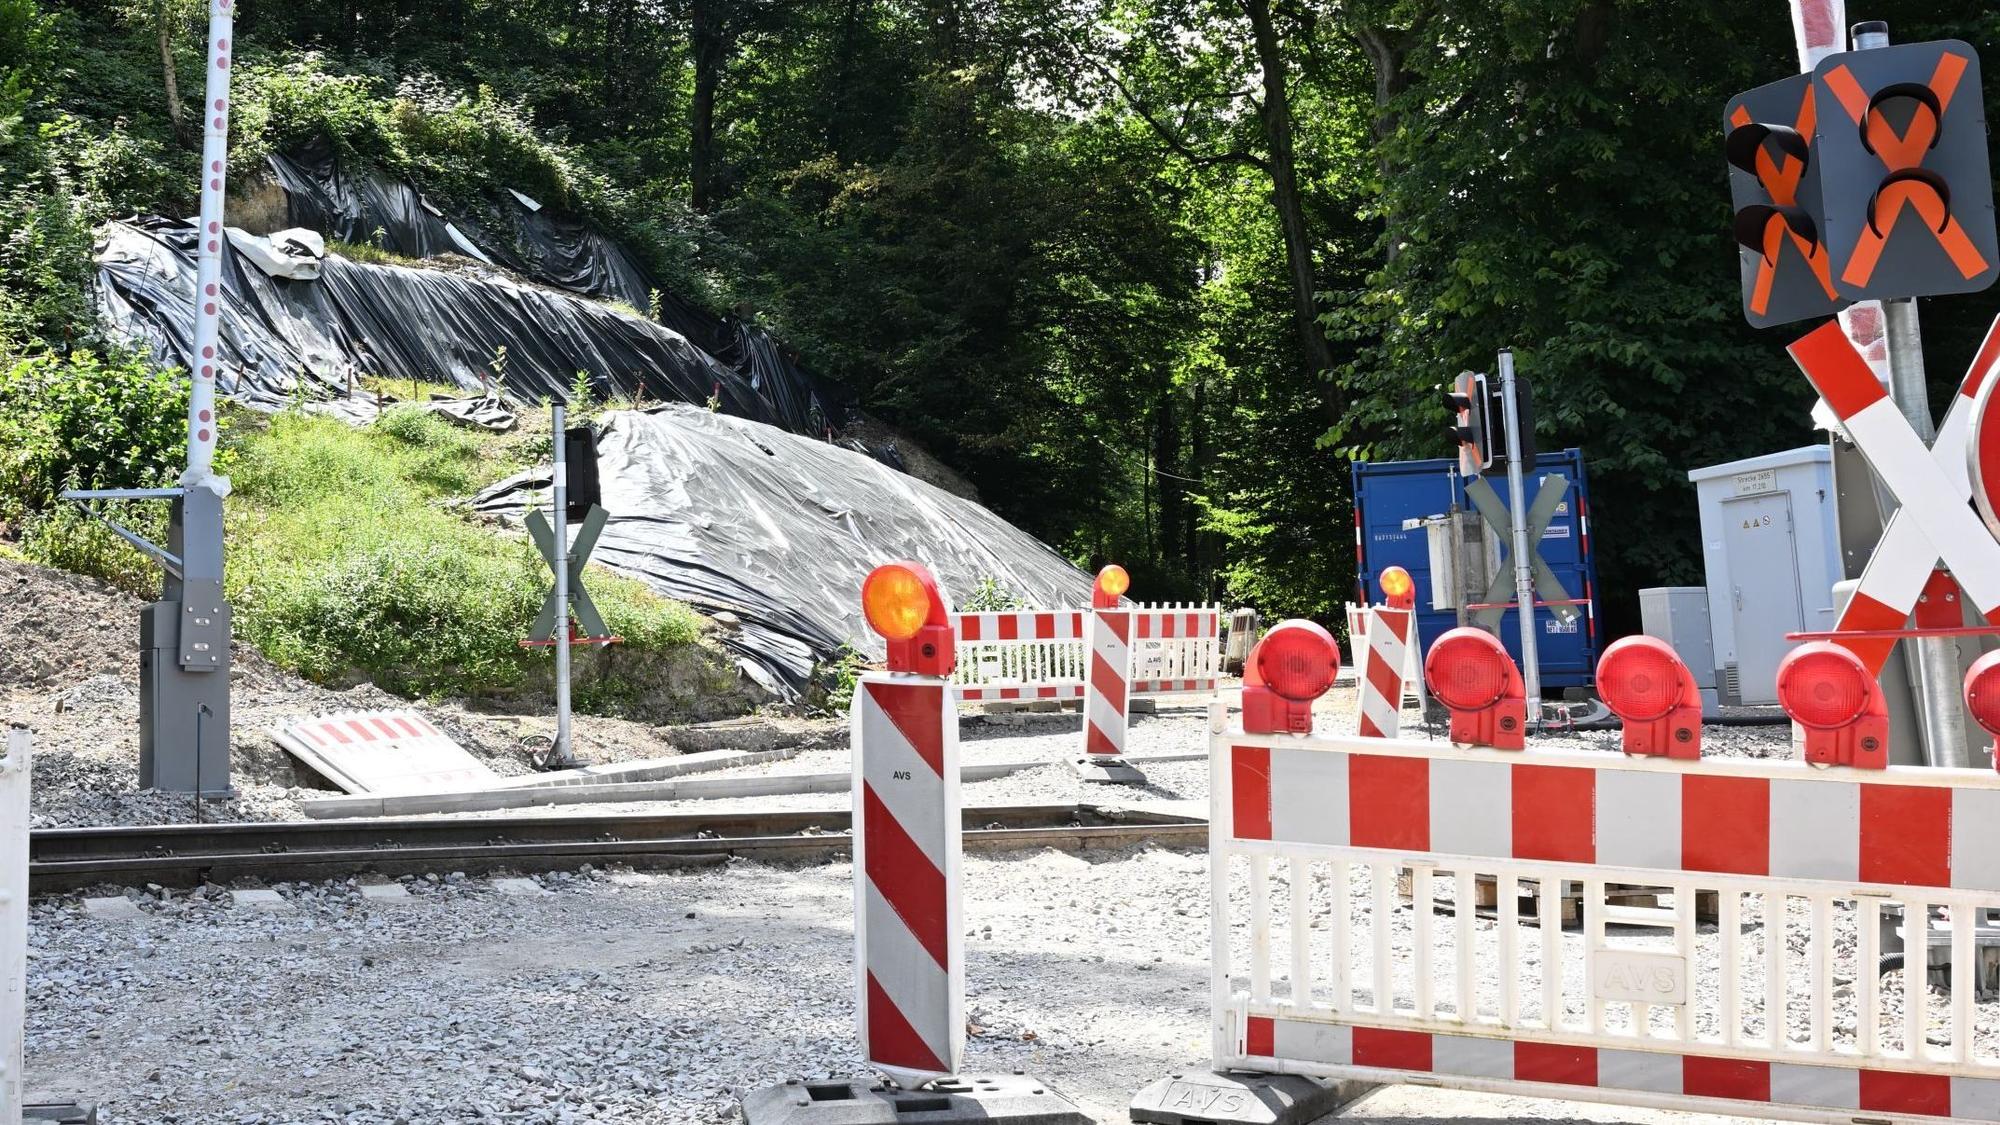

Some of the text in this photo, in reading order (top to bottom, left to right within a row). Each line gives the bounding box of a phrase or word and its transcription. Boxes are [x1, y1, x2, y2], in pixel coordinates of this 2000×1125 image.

[892, 770, 911, 780] AVS
[1604, 962, 1675, 994] AVS
[1173, 1088, 1244, 1114] AVS
